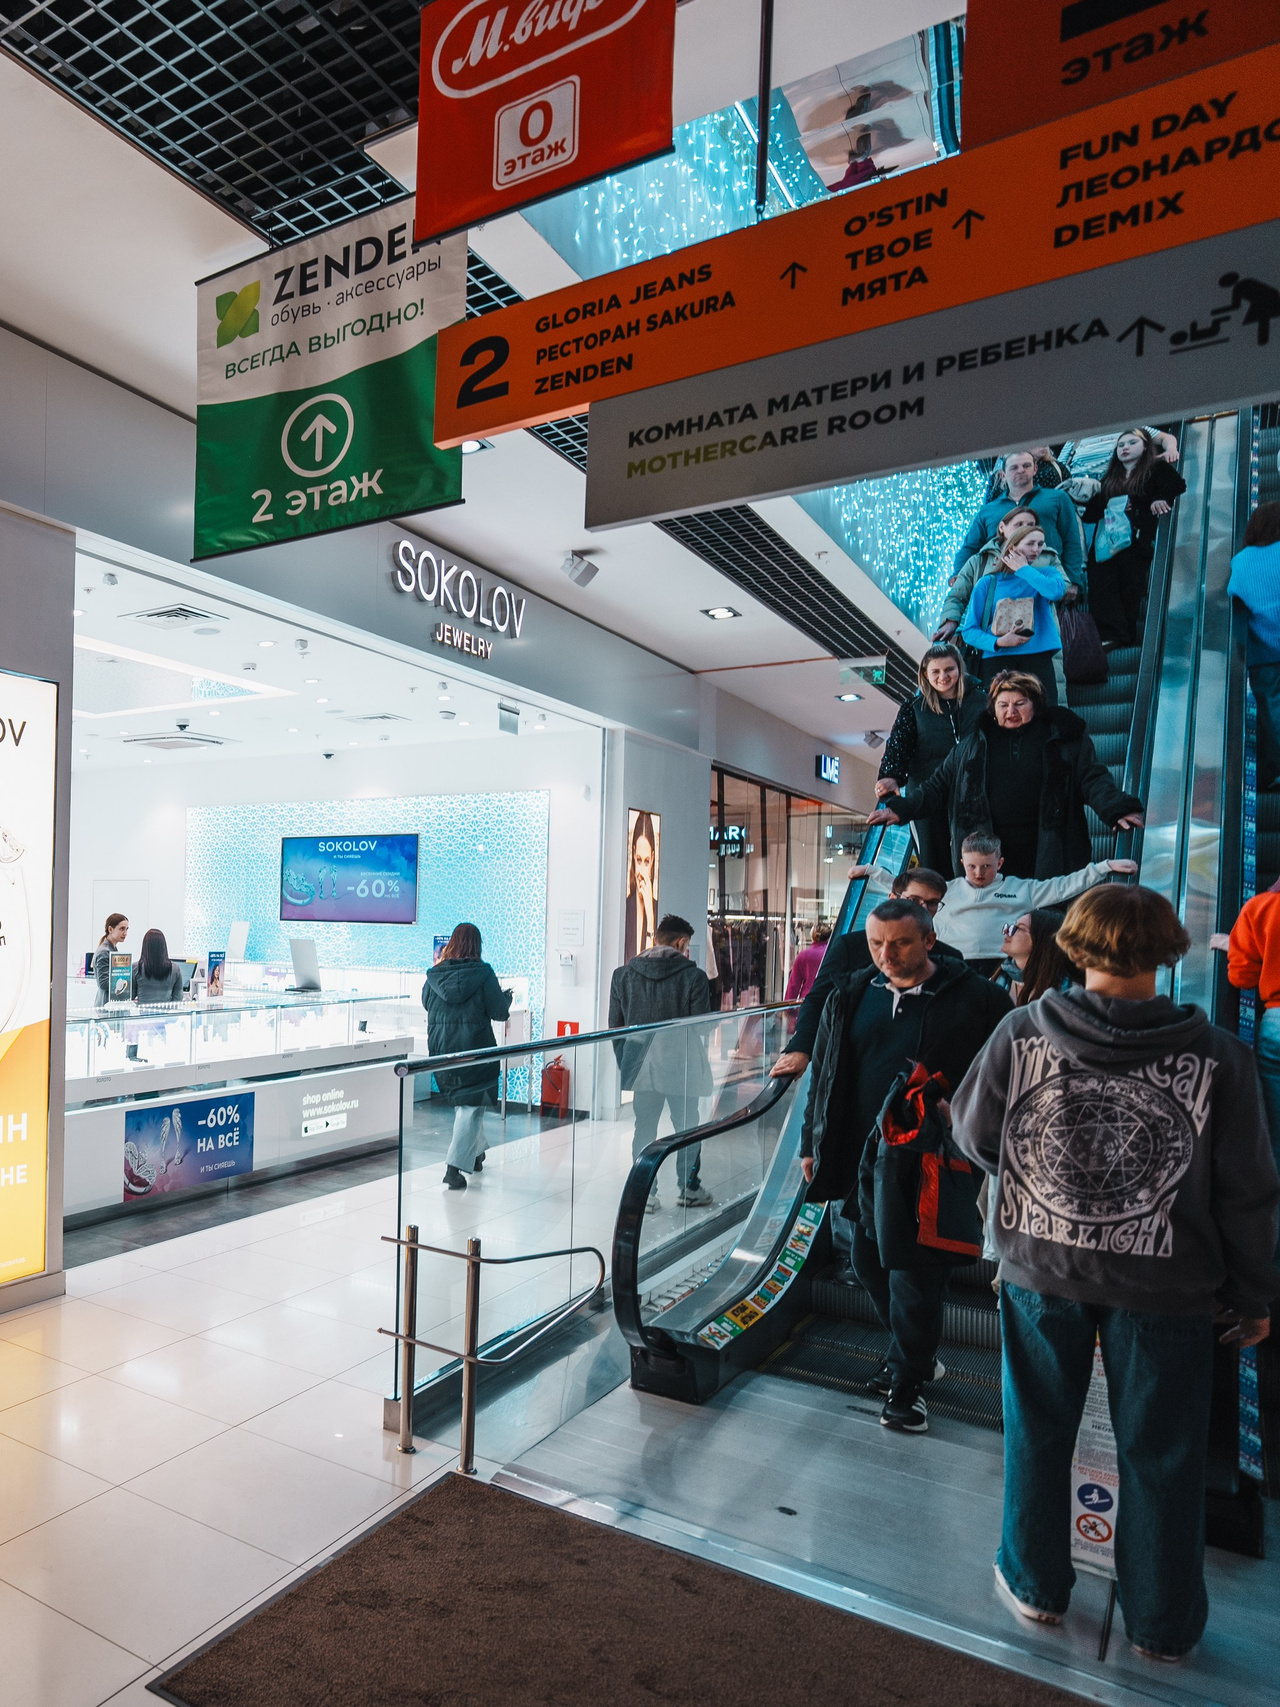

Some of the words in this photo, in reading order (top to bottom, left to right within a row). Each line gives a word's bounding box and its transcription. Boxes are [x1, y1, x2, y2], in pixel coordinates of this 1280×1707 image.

[1061, 10, 1209, 87] этаж
[504, 137, 567, 176] этаж
[1060, 126, 1139, 170] FUN
[1152, 91, 1238, 139] DAY
[1054, 191, 1185, 249] DEMIX
[272, 219, 442, 306] ZENDE
[845, 228, 933, 271] ТВОЕ
[271, 301, 322, 326] обувь
[335, 256, 441, 307] аксессуары
[536, 294, 622, 334] GLORIA
[630, 264, 713, 305] JEANS
[841, 267, 929, 307] МЯТА
[225, 342, 301, 380] ВСЕГДА
[308, 298, 425, 354] ВЫГОДНО!
[537, 319, 641, 365] РЕСТОРАН
[646, 290, 736, 333] SAKURA
[457, 335, 510, 409] 2
[534, 354, 634, 396] ZENDEN
[628, 403, 757, 449] КОМНАТА
[767, 369, 892, 416] МАТЕРИ
[902, 362, 924, 385] И
[935, 318, 1111, 378] РЕБЕНКА
[627, 420, 818, 479] MOTHERCARE
[827, 396, 925, 437] ROOM
[252, 489, 273, 523] 2
[285, 469, 384, 516] этаж
[396, 540, 526, 639] SOKOLOV
[436, 622, 493, 659] JEWELRY
[318, 840, 377, 852] SOKOLOV
[347, 879, 400, 898] -60%
[302, 1094, 321, 1105] shop
[322, 1088, 344, 1102] online
[302, 1099, 359, 1118] www.sokolov.ru
[1009, 1035, 1218, 1137] MYCAL
[197, 1136, 215, 1153] НА
[218, 1127, 239, 1149] ВСЁ
[198, 1104, 240, 1128] -60%
[214, 1160, 235, 1170] СИЯЕШЬ
